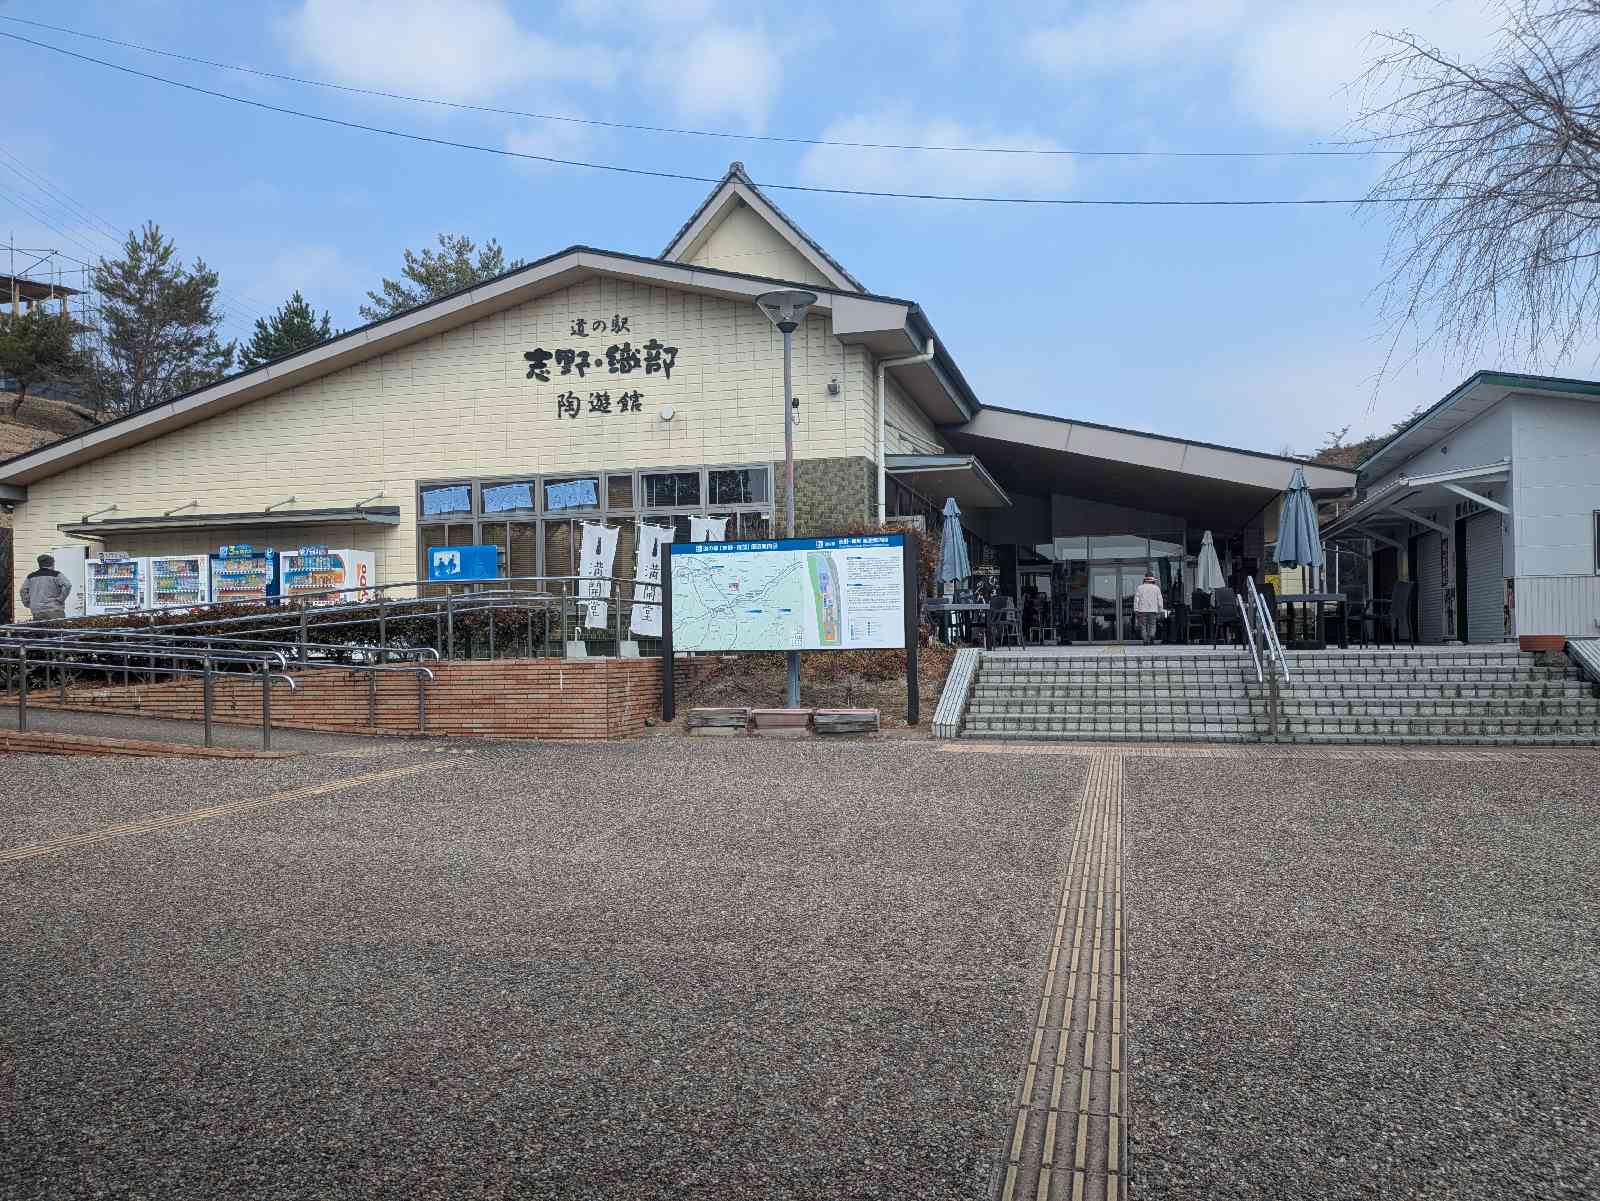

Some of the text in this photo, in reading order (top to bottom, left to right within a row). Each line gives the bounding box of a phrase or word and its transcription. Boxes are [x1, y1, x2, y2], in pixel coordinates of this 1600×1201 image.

[570, 314, 631, 337] 道の駅
[523, 338, 679, 382] 志野・織部
[557, 390, 645, 419] 陶遊館
